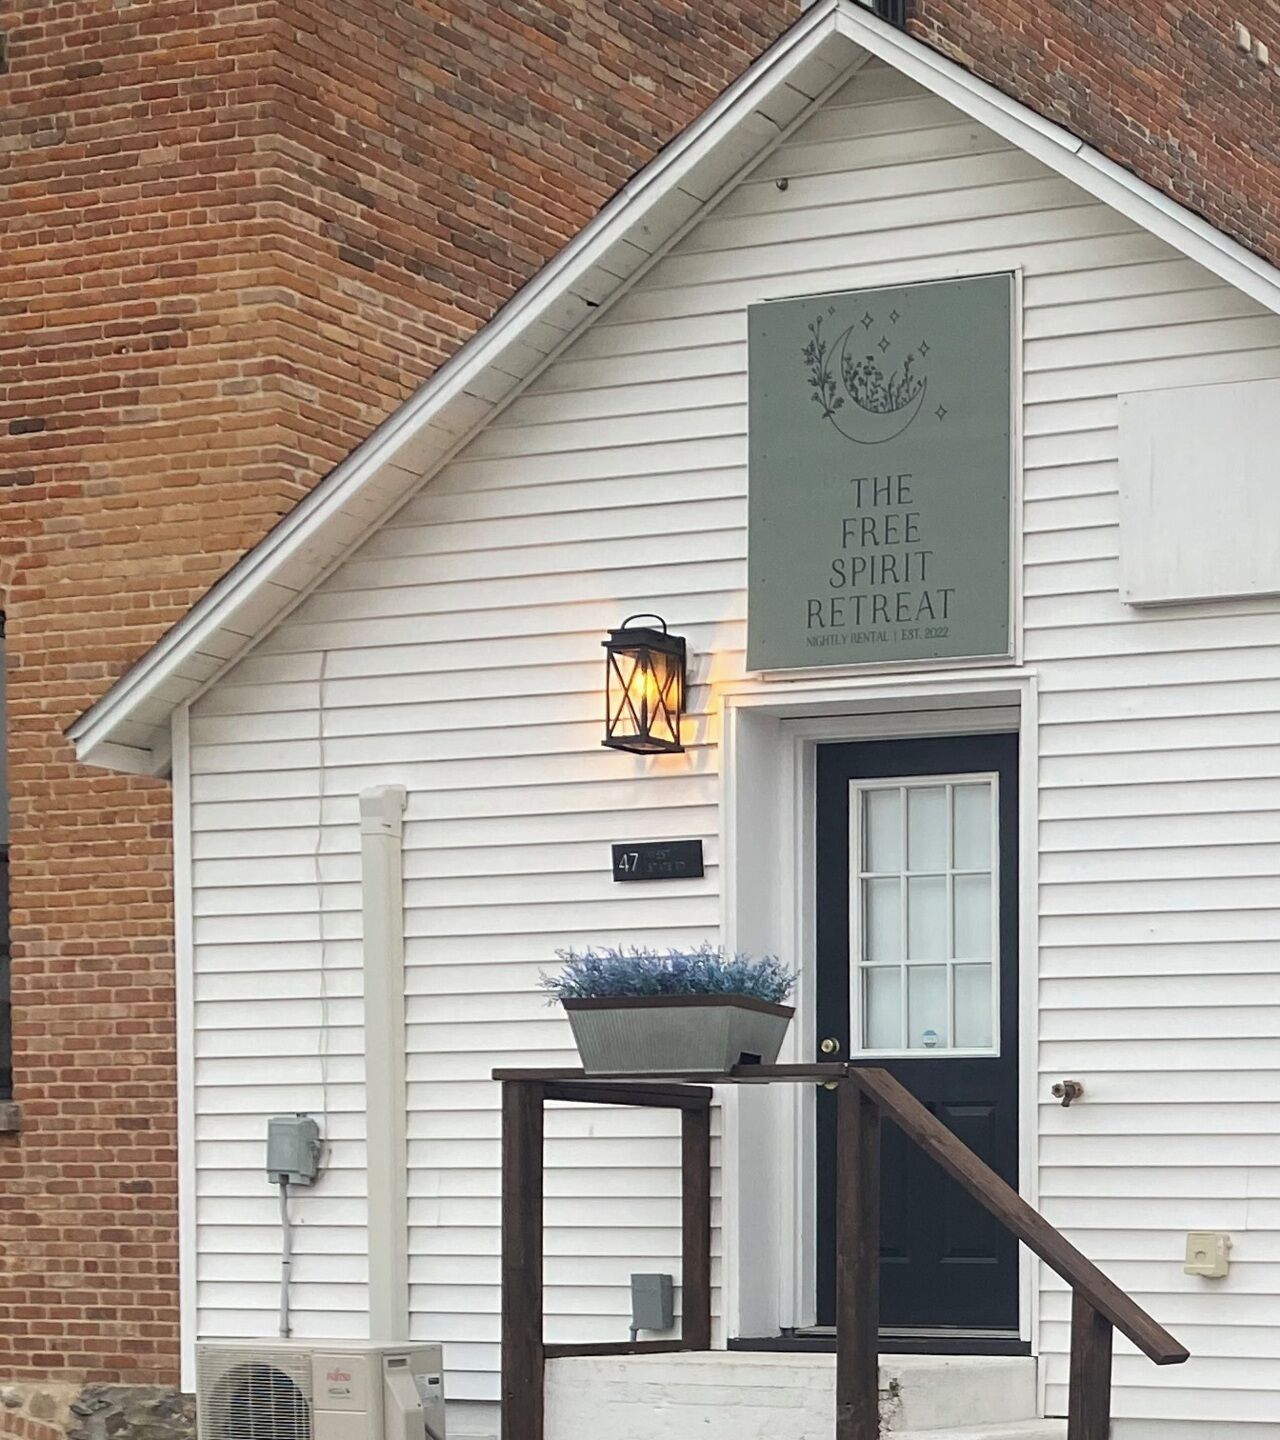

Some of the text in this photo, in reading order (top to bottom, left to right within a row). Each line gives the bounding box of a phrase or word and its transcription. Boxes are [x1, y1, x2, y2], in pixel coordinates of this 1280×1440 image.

[850, 474, 913, 508] THE
[841, 512, 921, 549] FREE
[829, 551, 933, 589] SPIRIT
[807, 588, 955, 629] RETREAT
[806, 626, 949, 647] NIGHTLY RENTAL EST. 2022
[618, 852, 639, 872] 47
